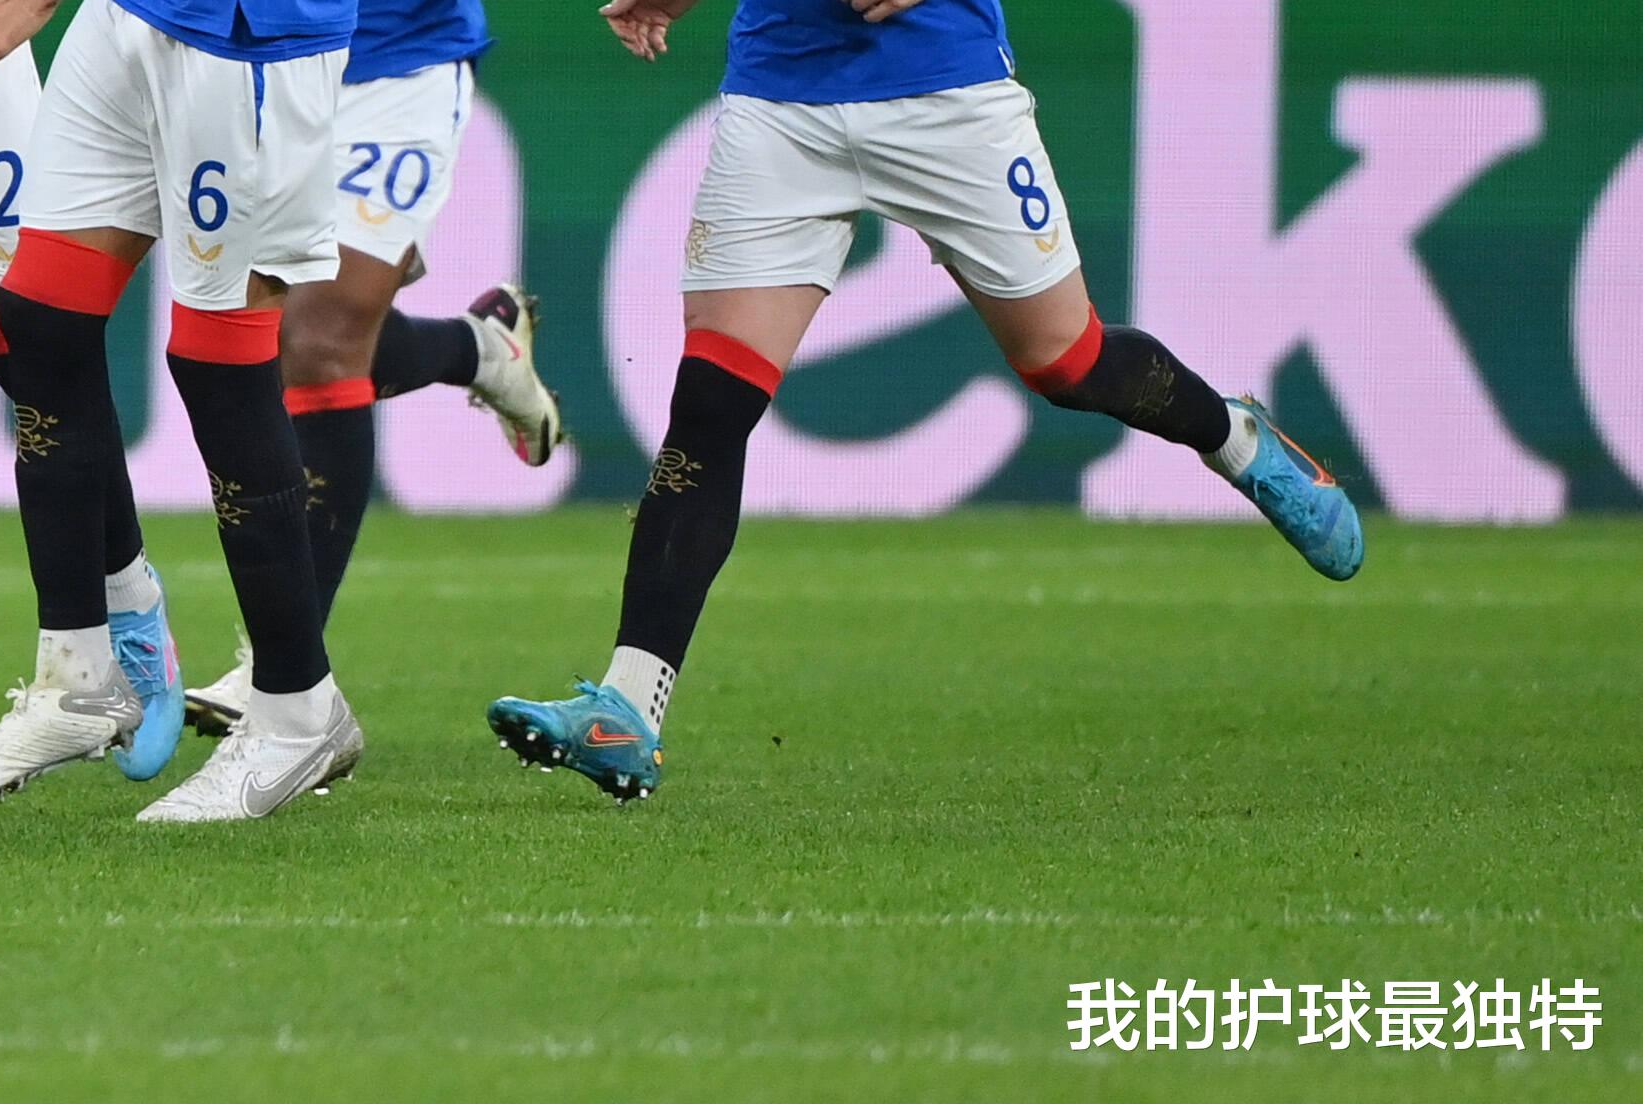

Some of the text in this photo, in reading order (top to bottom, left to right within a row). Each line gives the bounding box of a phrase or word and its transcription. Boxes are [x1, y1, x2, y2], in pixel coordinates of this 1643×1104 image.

[188, 159, 229, 232] 6
[337, 142, 431, 211] 20
[1007, 156, 1050, 231] 8
